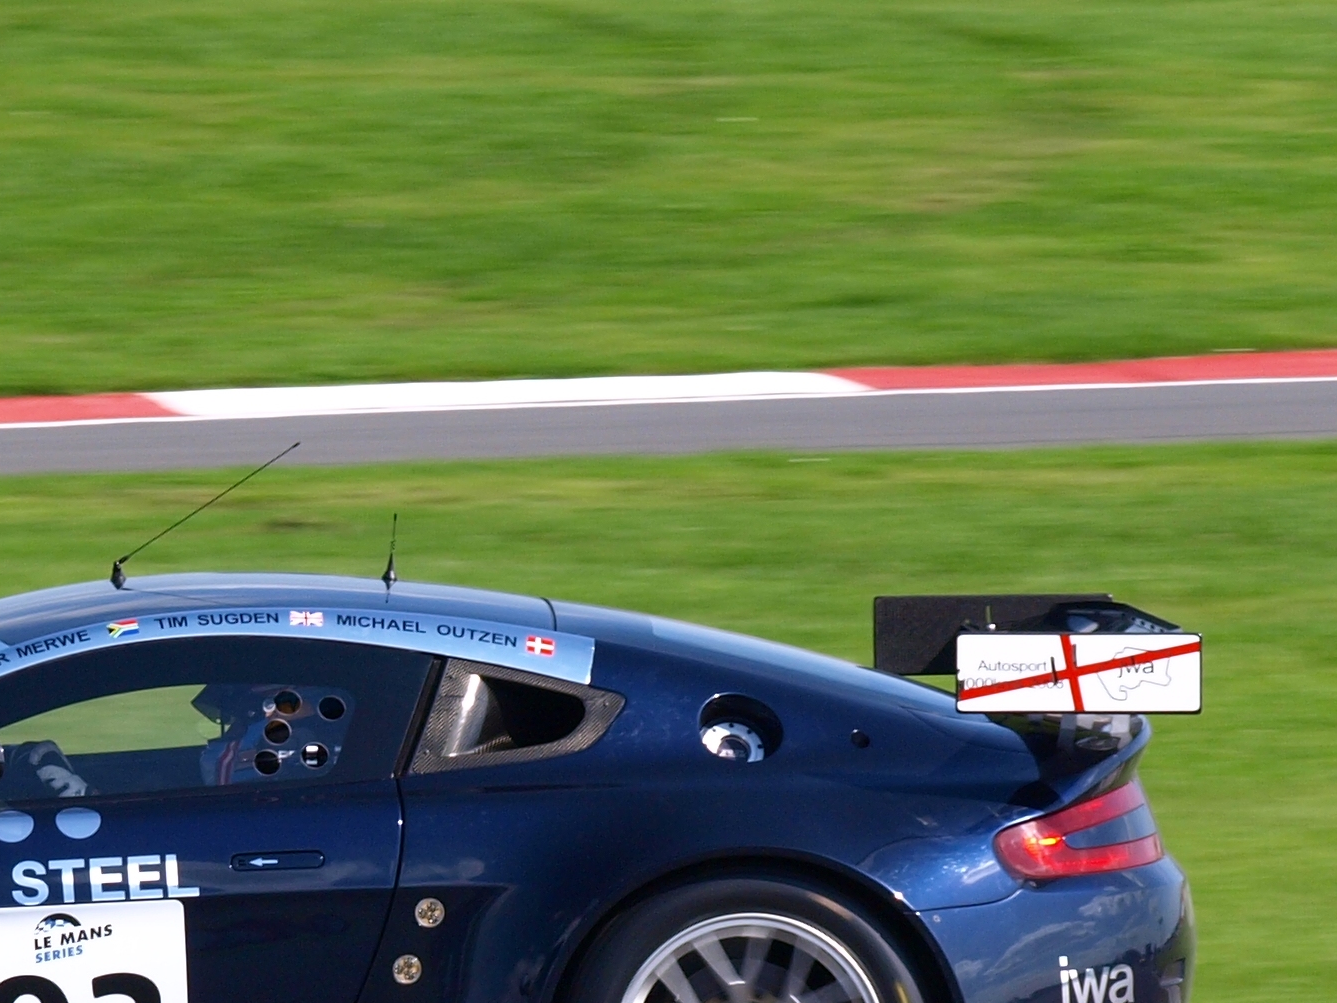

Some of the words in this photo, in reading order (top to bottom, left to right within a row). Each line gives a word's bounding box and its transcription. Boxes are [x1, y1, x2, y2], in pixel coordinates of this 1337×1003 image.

[153, 615, 188, 629] TIM
[197, 612, 279, 627] SUGDEN
[336, 614, 426, 634] MICHAEL
[437, 624, 517, 647] OUTZEN
[16, 630, 91, 658] MERWE
[978, 660, 1047, 673] Autosport
[12, 854, 200, 906] STEEL
[34, 936, 51, 950] LE
[60, 925, 113, 946] MANS
[35, 945, 83, 964] SERIES
